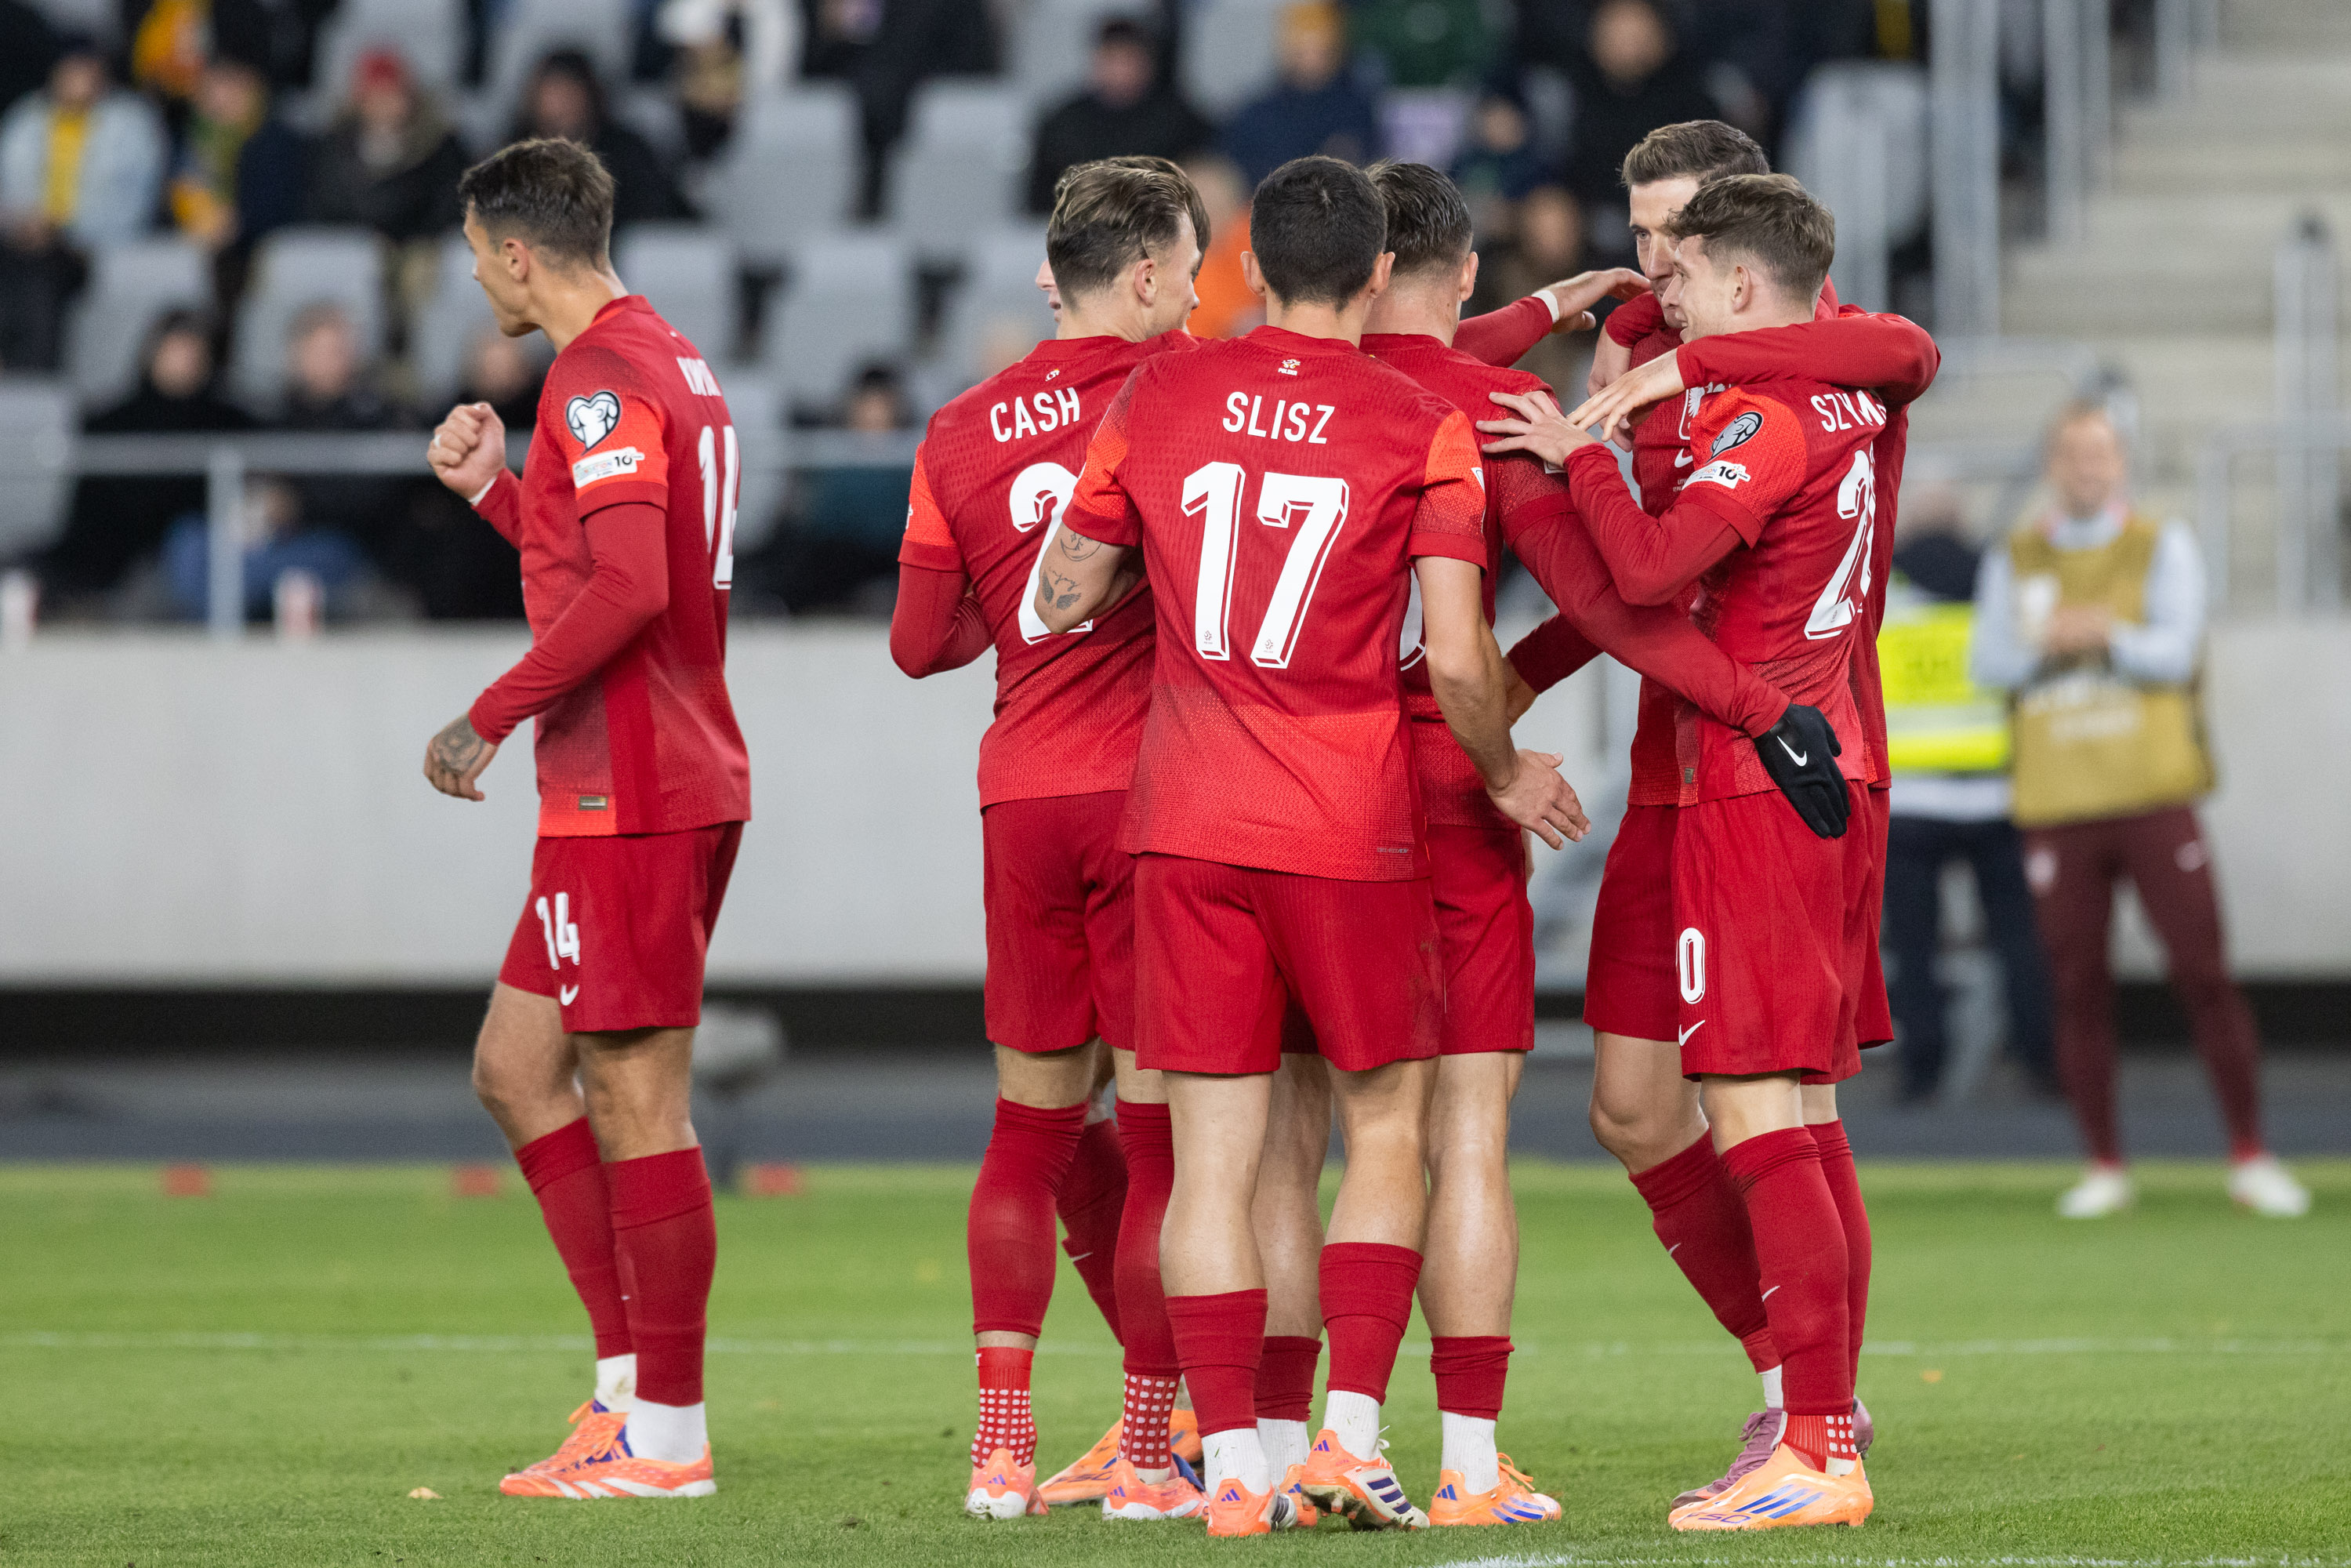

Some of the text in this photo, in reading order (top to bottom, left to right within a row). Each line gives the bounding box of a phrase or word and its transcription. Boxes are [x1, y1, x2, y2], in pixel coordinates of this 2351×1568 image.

[990, 387, 1080, 443] CASH
[1222, 391, 1335, 445] SLISZ
[1009, 462, 1093, 646] 2
[1181, 461, 1350, 669] 17
[535, 891, 580, 971] 14
